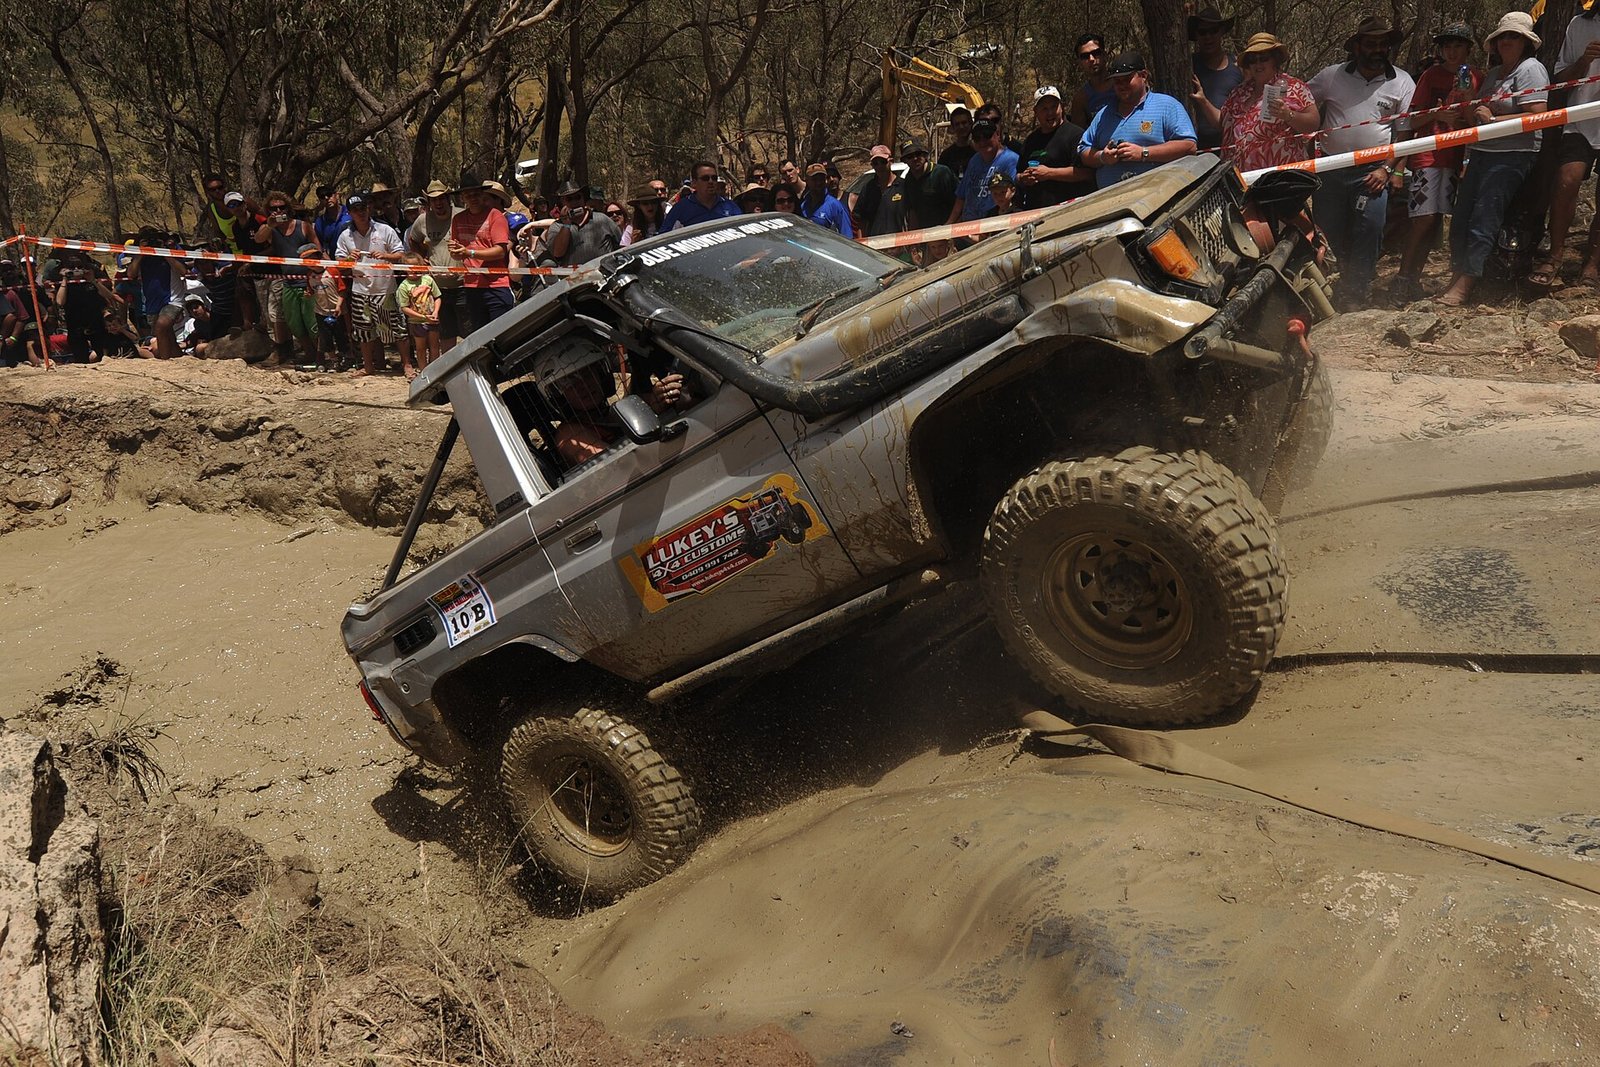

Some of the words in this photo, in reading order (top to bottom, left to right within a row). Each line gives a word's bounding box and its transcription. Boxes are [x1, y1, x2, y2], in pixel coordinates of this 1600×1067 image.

[1527, 112, 1562, 124] STIHL
[1439, 129, 1474, 141] STIHL
[1359, 145, 1390, 158] STIHL
[640, 246, 681, 266] BLUE
[669, 229, 747, 255] MOUNTAINS
[738, 222, 769, 234] 4WD
[761, 218, 794, 230] CLUB
[646, 510, 740, 569] LUKEY'S
[684, 528, 745, 564] CUSTOMS
[681, 566, 704, 581] 0409
[705, 558, 721, 570] 991
[723, 548, 740, 561] 742
[691, 556, 748, 588] www.lukeys4x4.com
